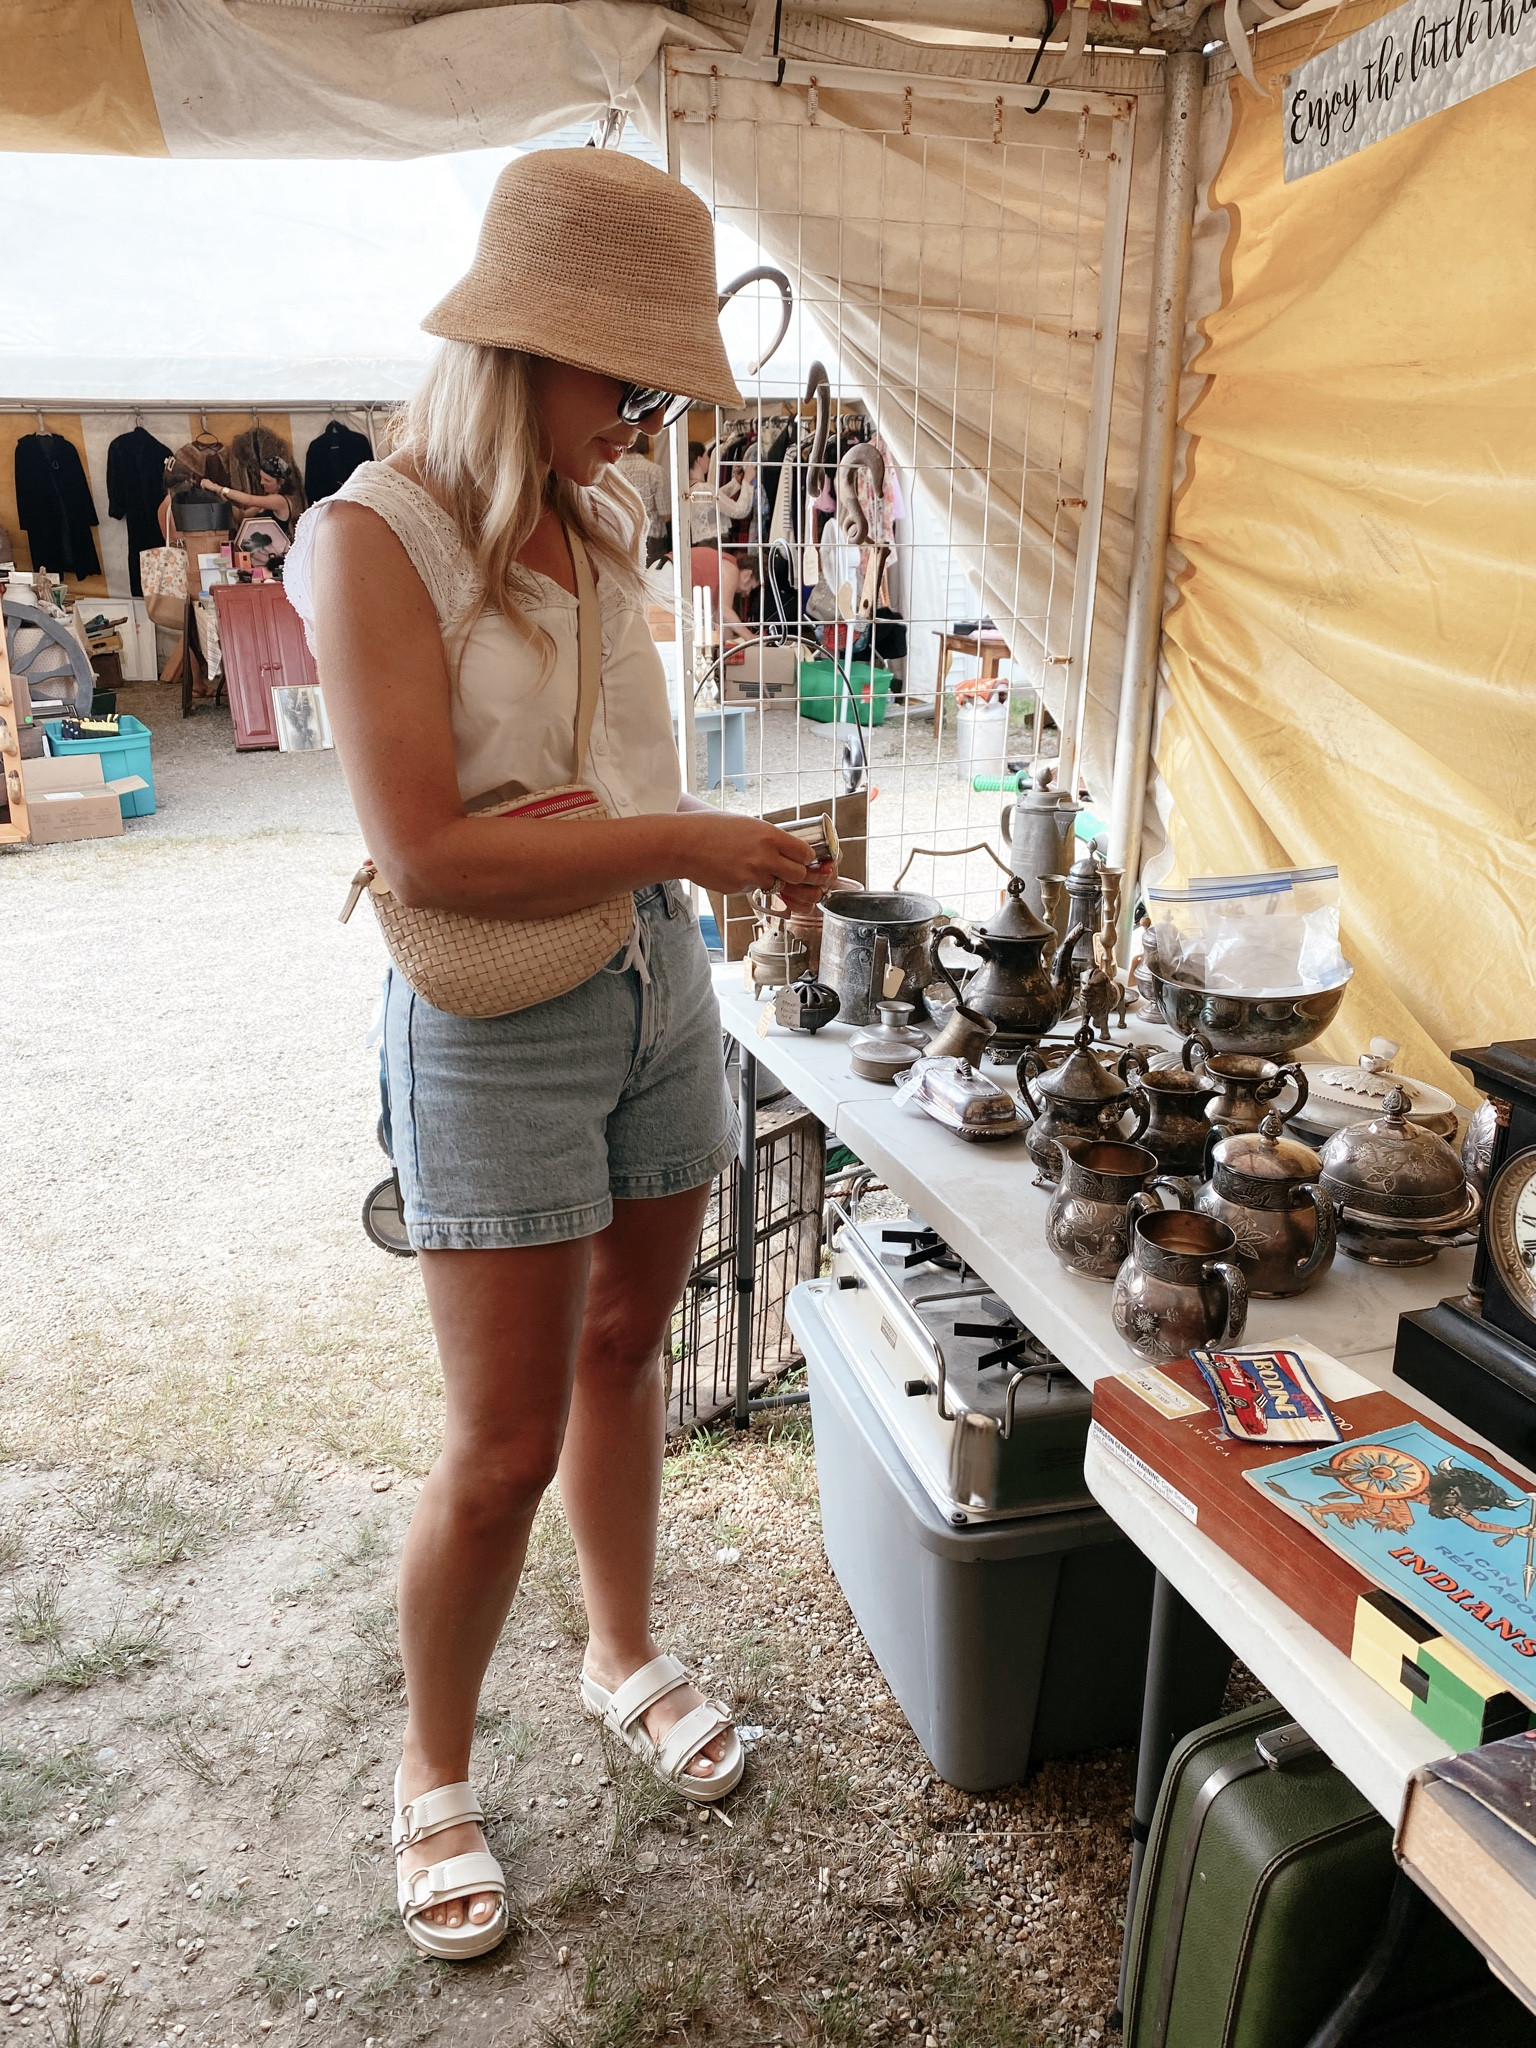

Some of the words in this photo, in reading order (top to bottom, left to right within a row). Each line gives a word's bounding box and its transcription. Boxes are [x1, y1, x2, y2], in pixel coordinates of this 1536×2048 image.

[1291, 80, 1363, 146] Enjoy
[1363, 36, 1404, 102] the
[1411, 0, 1482, 82] little
[1252, 1360, 1299, 1416] BODINE
[1094, 1422, 1115, 1444] SURGEON
[1115, 1441, 1136, 1463] GENERAL
[1179, 1419, 1230, 1457] JAMAICA
[1434, 1545, 1489, 1582] READ
[1488, 1585, 1536, 1622] ABO
[1475, 1558, 1518, 1587] CAN
[1388, 1546, 1536, 1657] INDIANS
